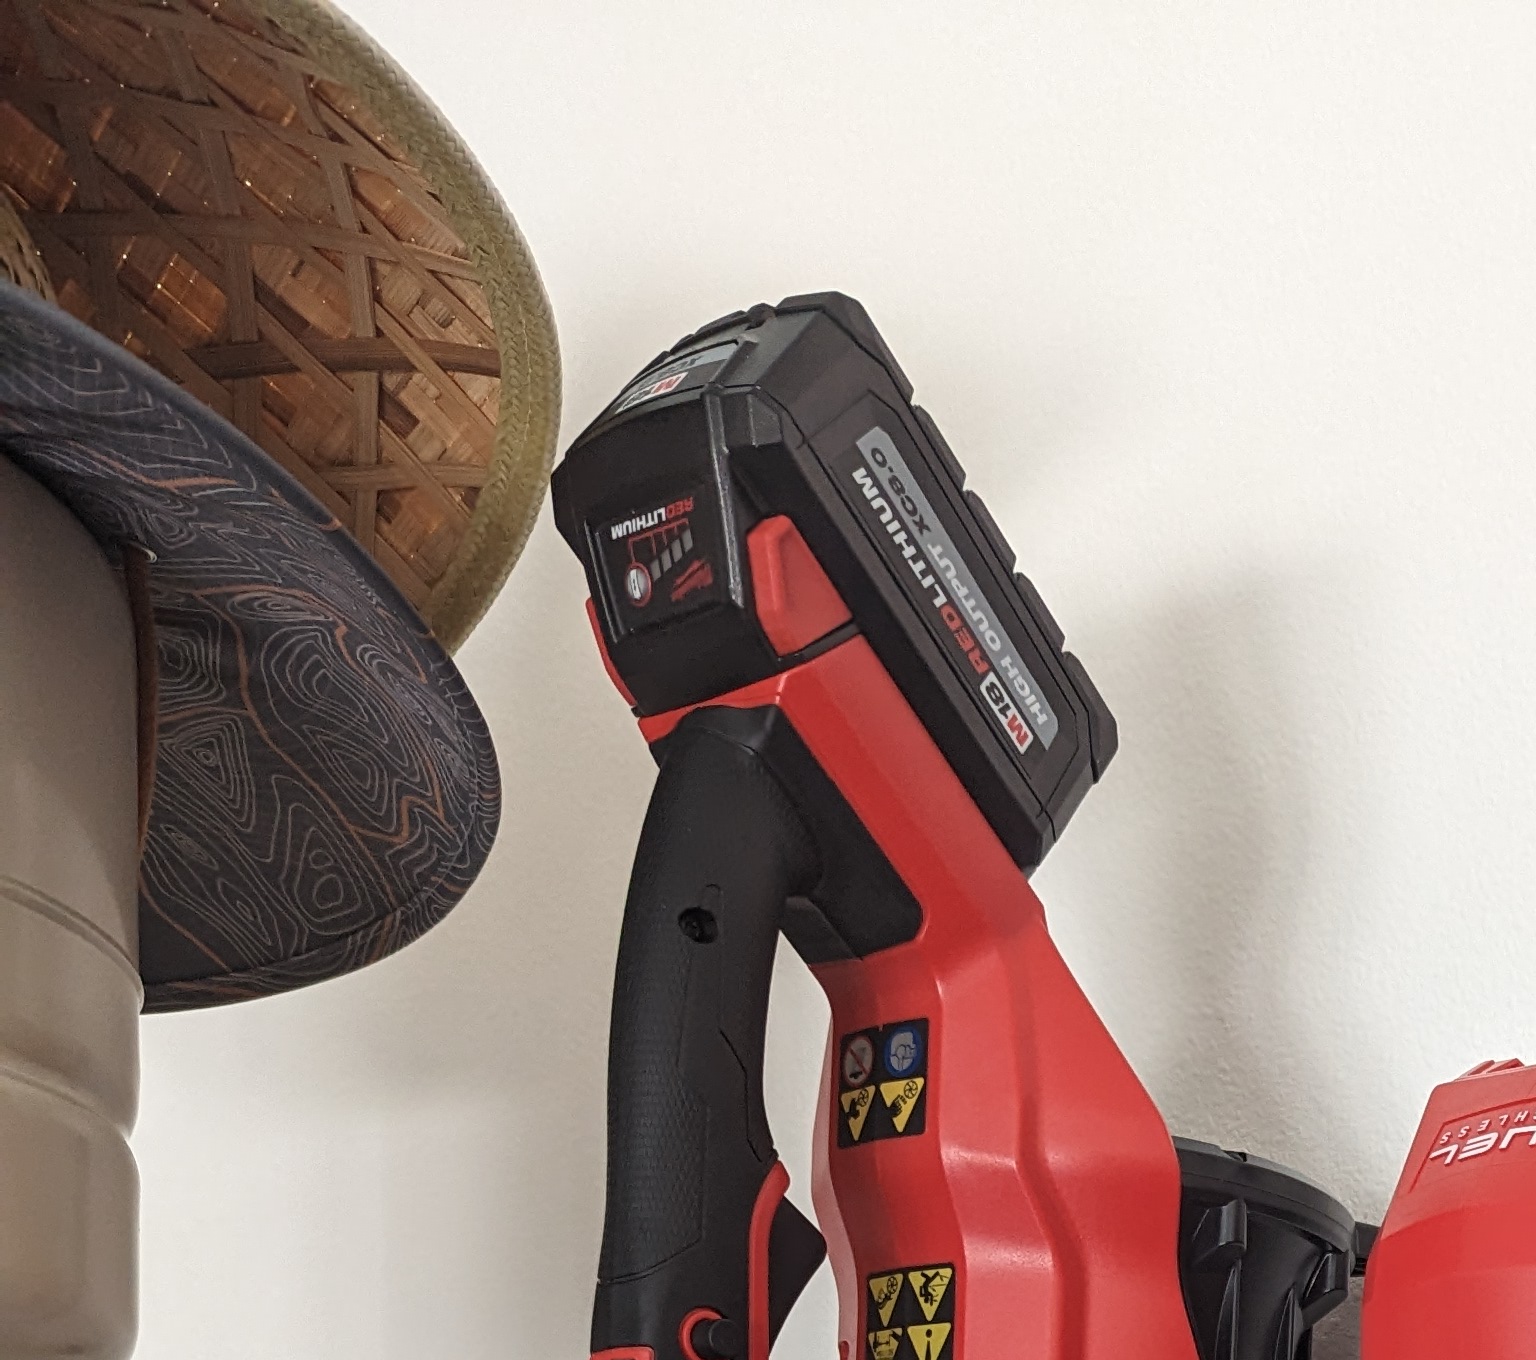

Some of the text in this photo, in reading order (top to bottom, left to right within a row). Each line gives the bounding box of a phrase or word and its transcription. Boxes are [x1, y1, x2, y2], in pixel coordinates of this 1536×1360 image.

[610, 496, 694, 541] REDLITHIUM
[851, 465, 1030, 746] M18 REDLITHIUM
[868, 445, 1048, 725] HIGH OUTPUT XC8.0
